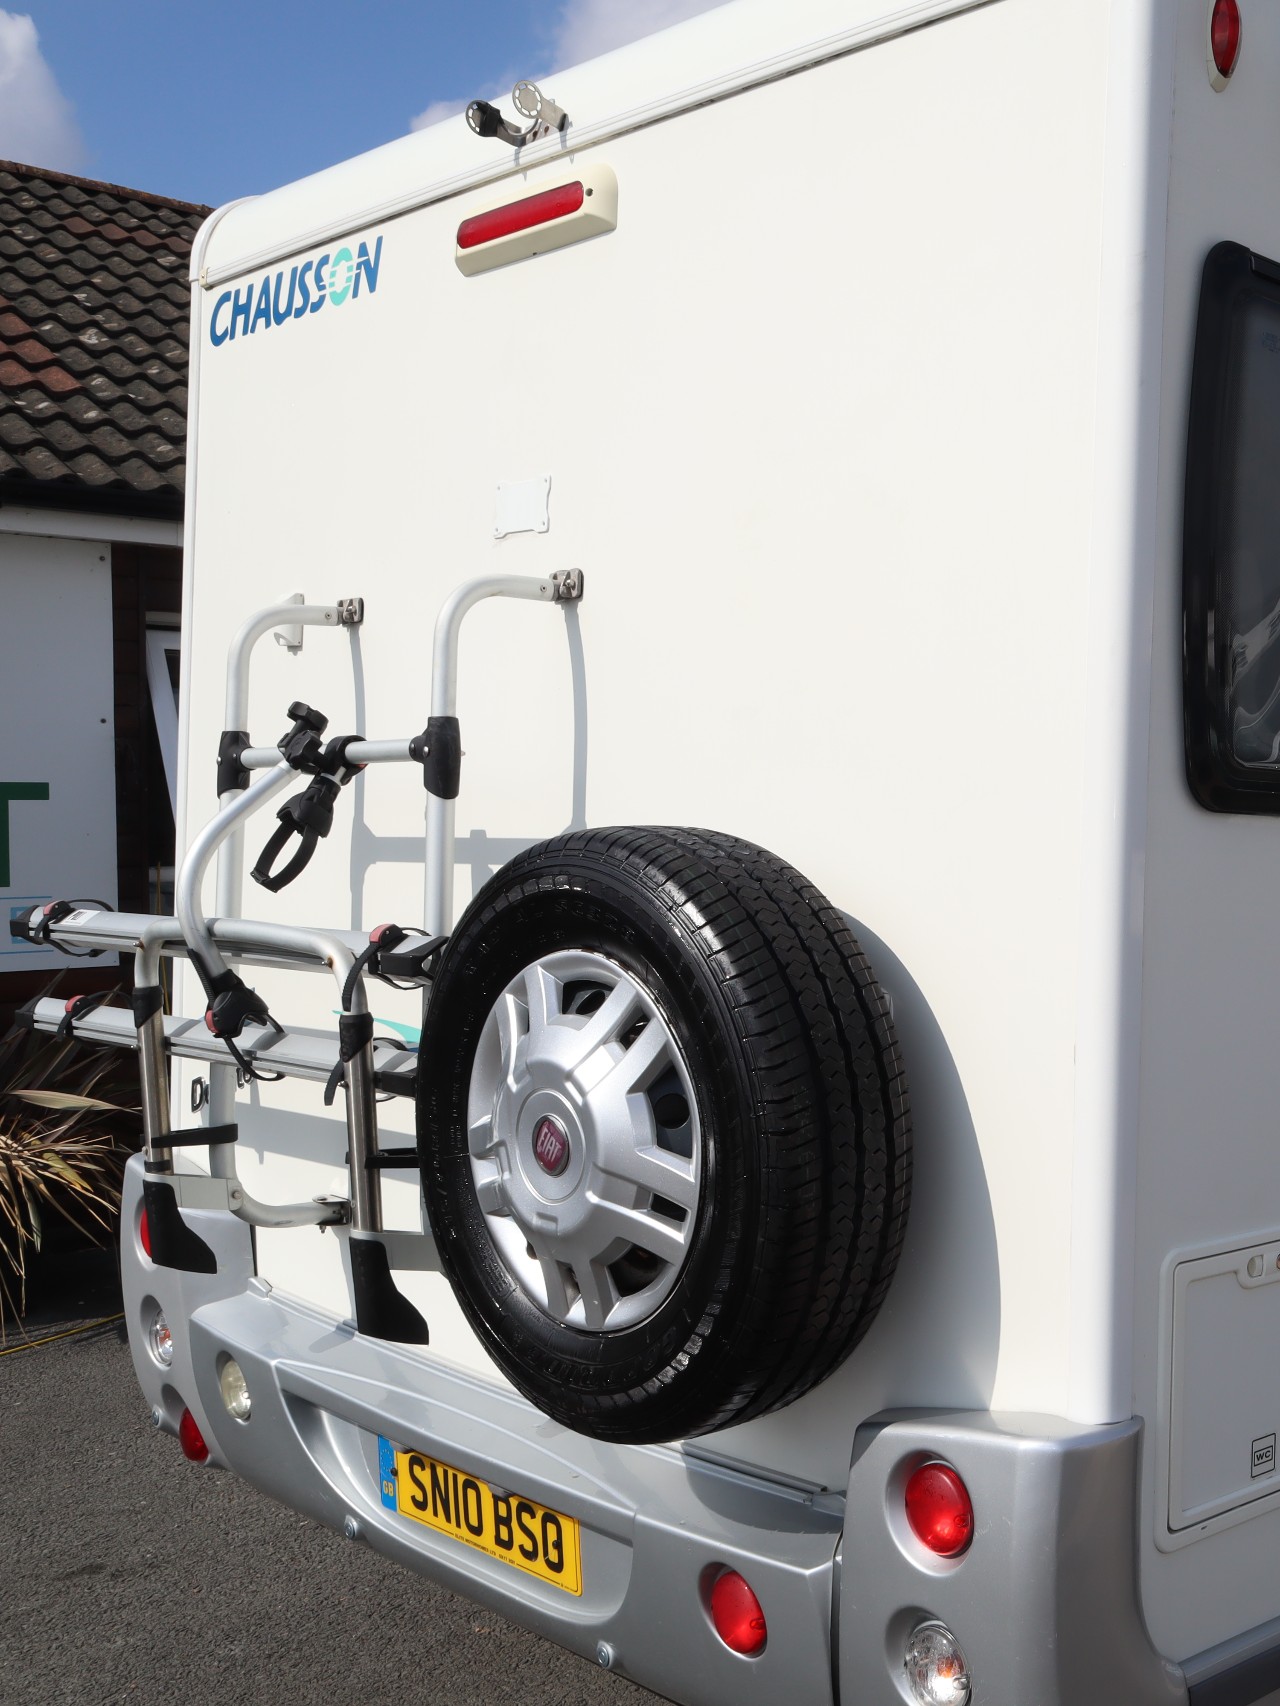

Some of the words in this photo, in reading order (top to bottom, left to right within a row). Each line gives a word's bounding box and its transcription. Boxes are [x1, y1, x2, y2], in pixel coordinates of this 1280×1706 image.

[210, 235, 384, 347] CHAUSSON
[537, 1127, 562, 1163] FIAT
[1256, 1450, 1271, 1461] WC
[383, 1480, 394, 1497] GB
[408, 1454, 484, 1537] SN10
